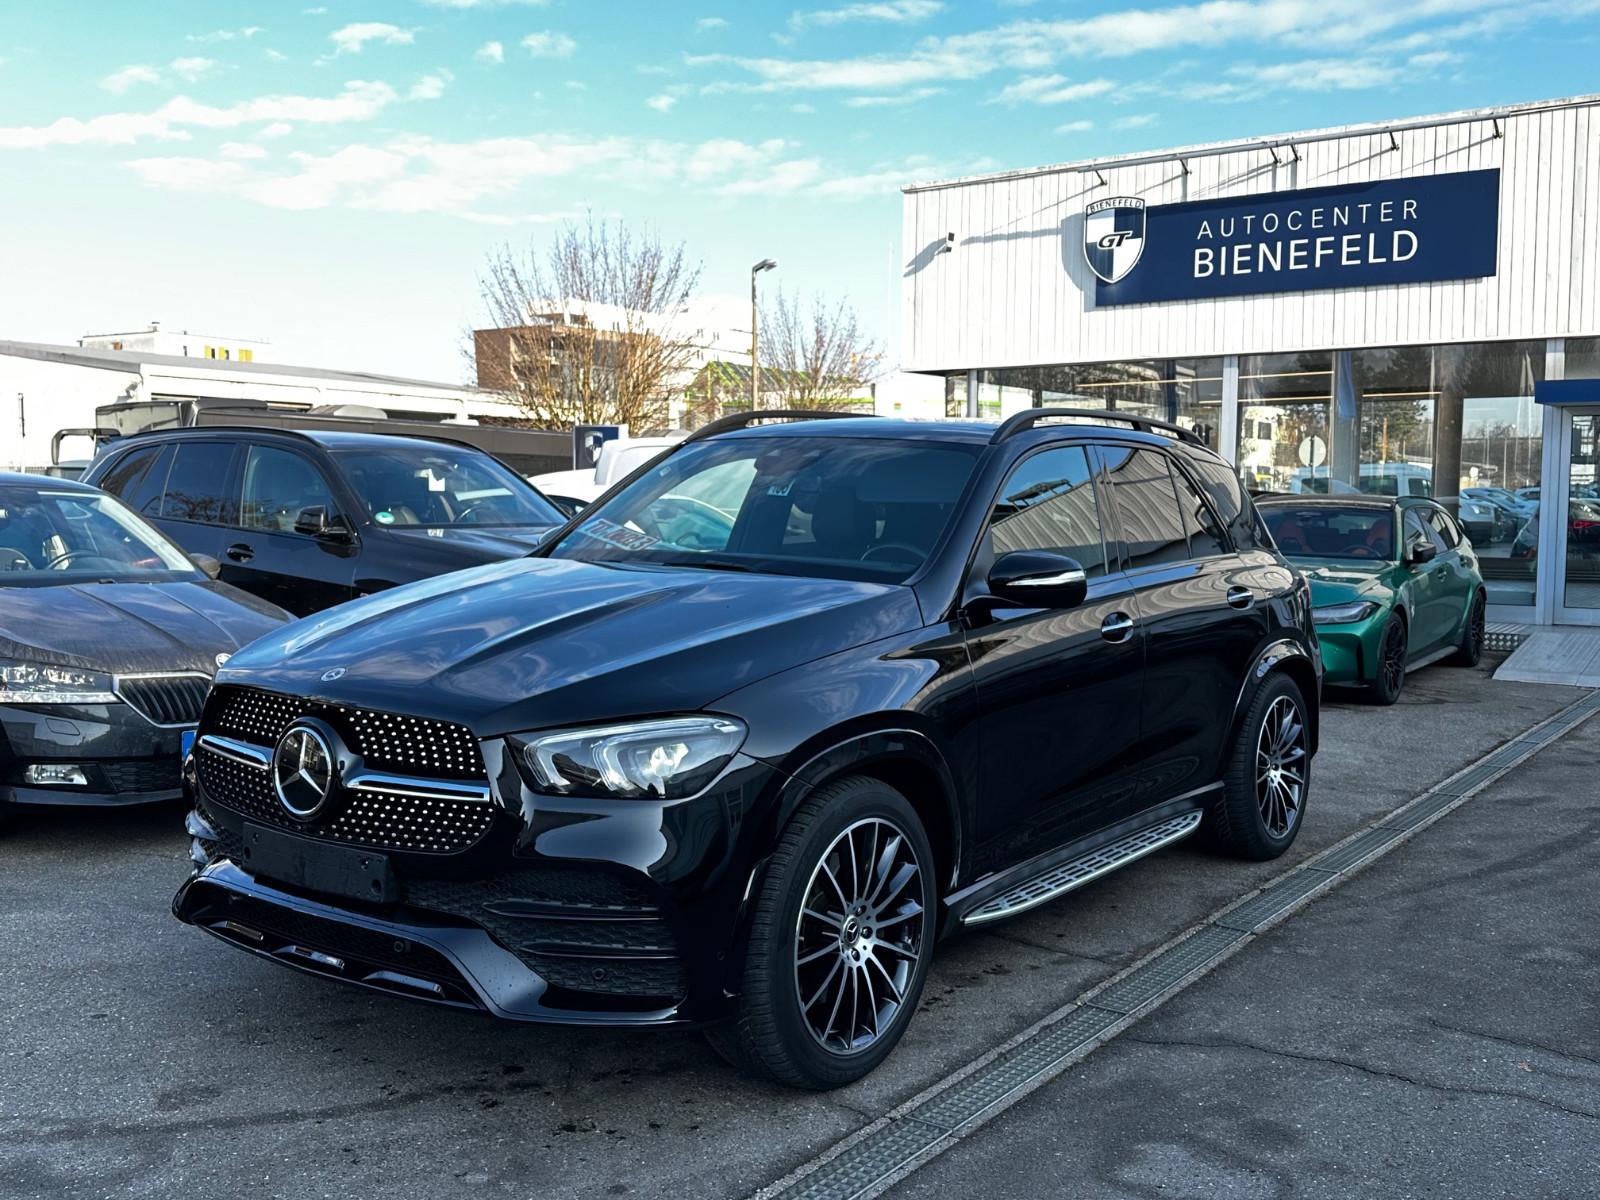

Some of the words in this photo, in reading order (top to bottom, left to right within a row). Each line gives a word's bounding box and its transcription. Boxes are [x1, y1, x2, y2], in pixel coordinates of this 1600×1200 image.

[1089, 199, 1142, 213] BIENEFELD
[1197, 199, 1418, 240] AUTOCENTER
[1098, 231, 1133, 248] GT
[1194, 229, 1418, 278] BIENEFELD
